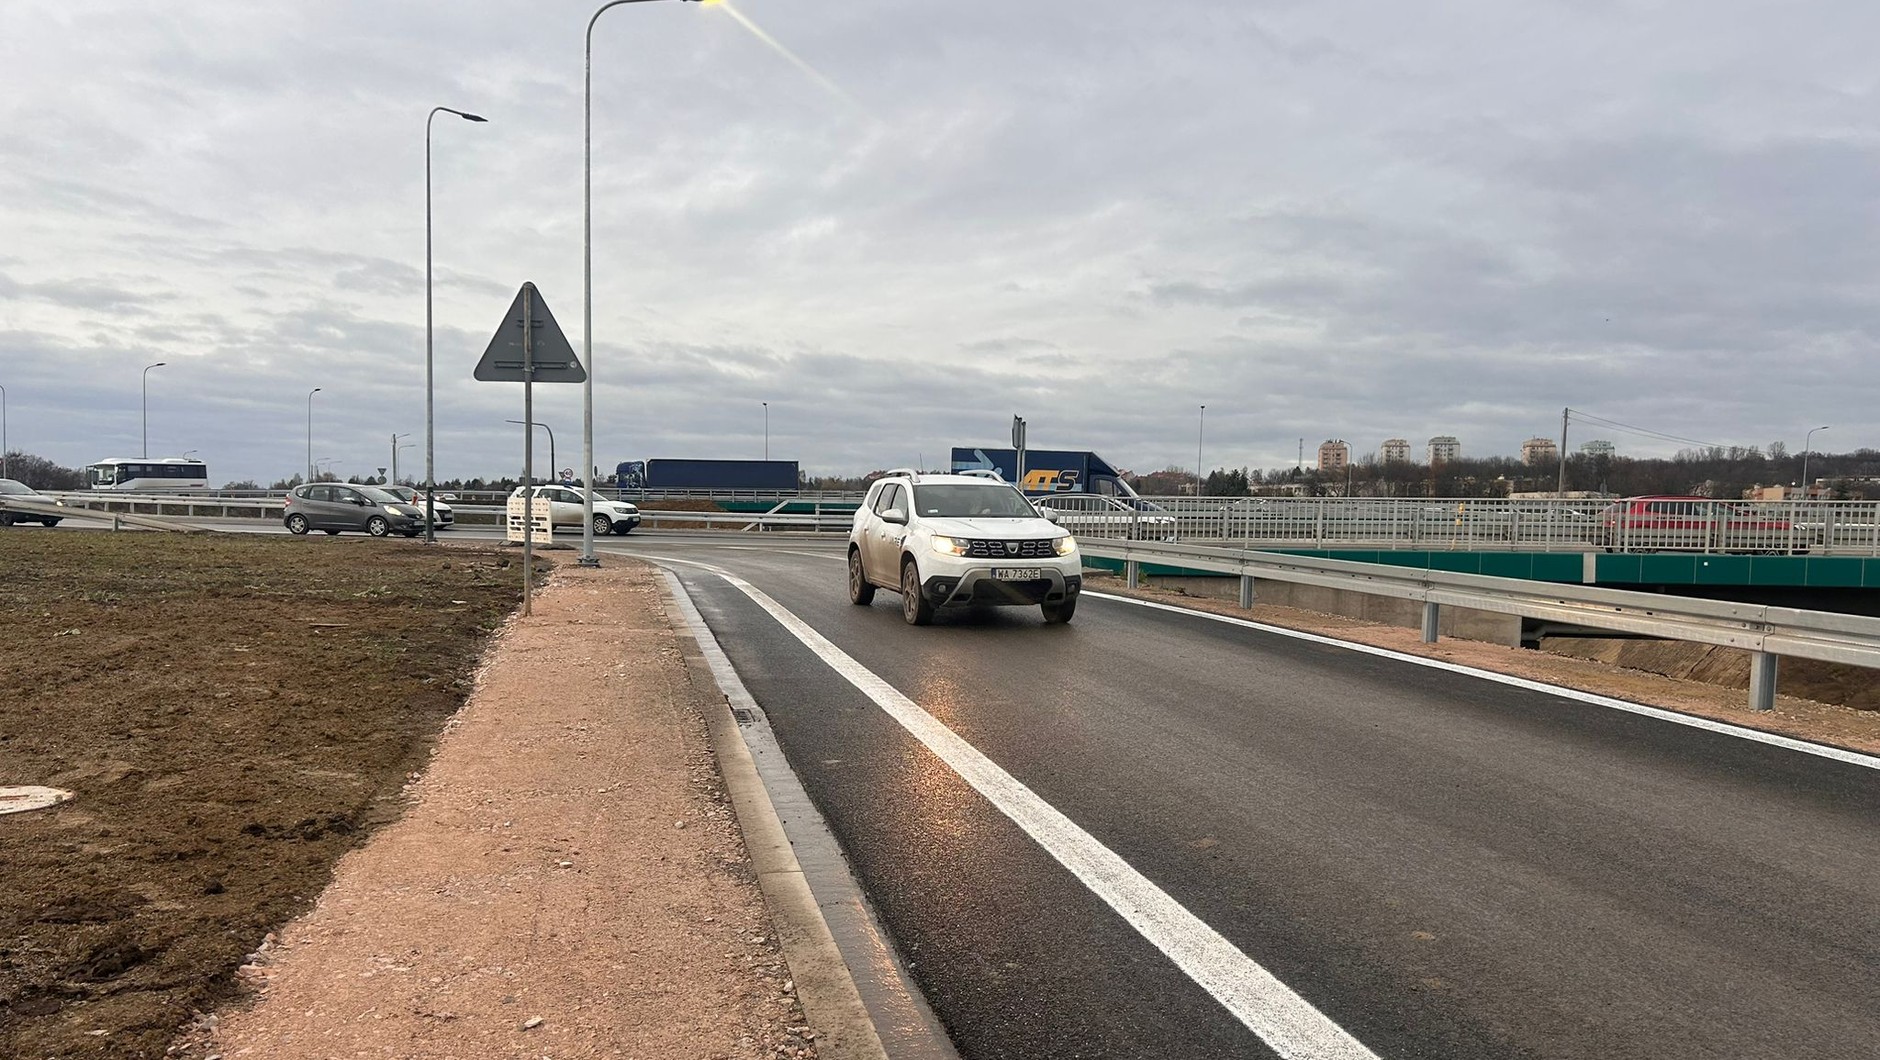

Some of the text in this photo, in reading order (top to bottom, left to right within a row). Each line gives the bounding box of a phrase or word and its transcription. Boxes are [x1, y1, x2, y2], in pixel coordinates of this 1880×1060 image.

[1021, 469, 1079, 492] ATS
[998, 570, 1039, 578] WA 7362E
